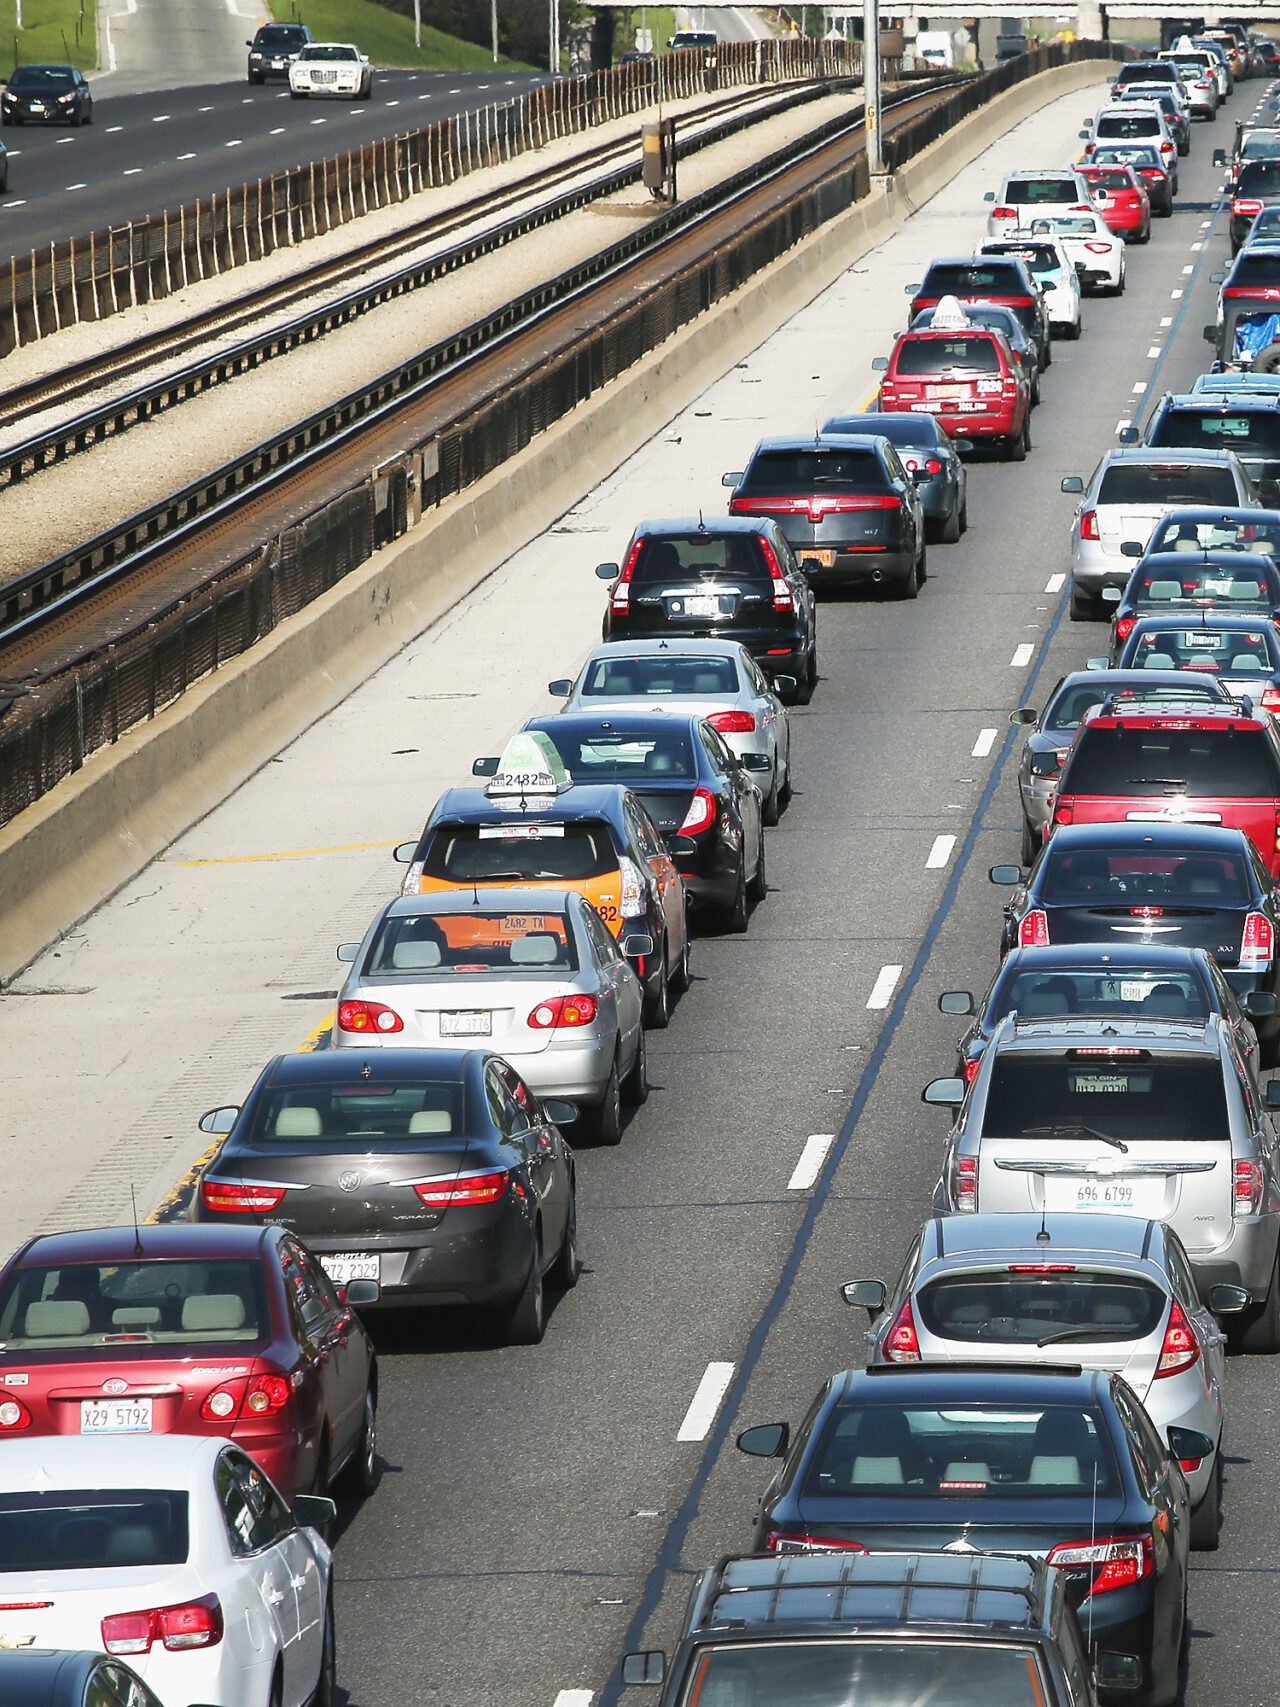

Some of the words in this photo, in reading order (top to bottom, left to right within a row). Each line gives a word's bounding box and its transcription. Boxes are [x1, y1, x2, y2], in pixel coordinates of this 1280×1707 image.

[505, 773, 539, 786] 2482
[504, 917, 527, 929] 2482
[533, 917, 544, 928] TX
[1077, 1187, 1098, 1201] 696
[1105, 1187, 1133, 1201] 6799
[349, 1263, 378, 1279] 2329
[84, 1410, 108, 1426] X29
[116, 1408, 149, 1425] 5792
